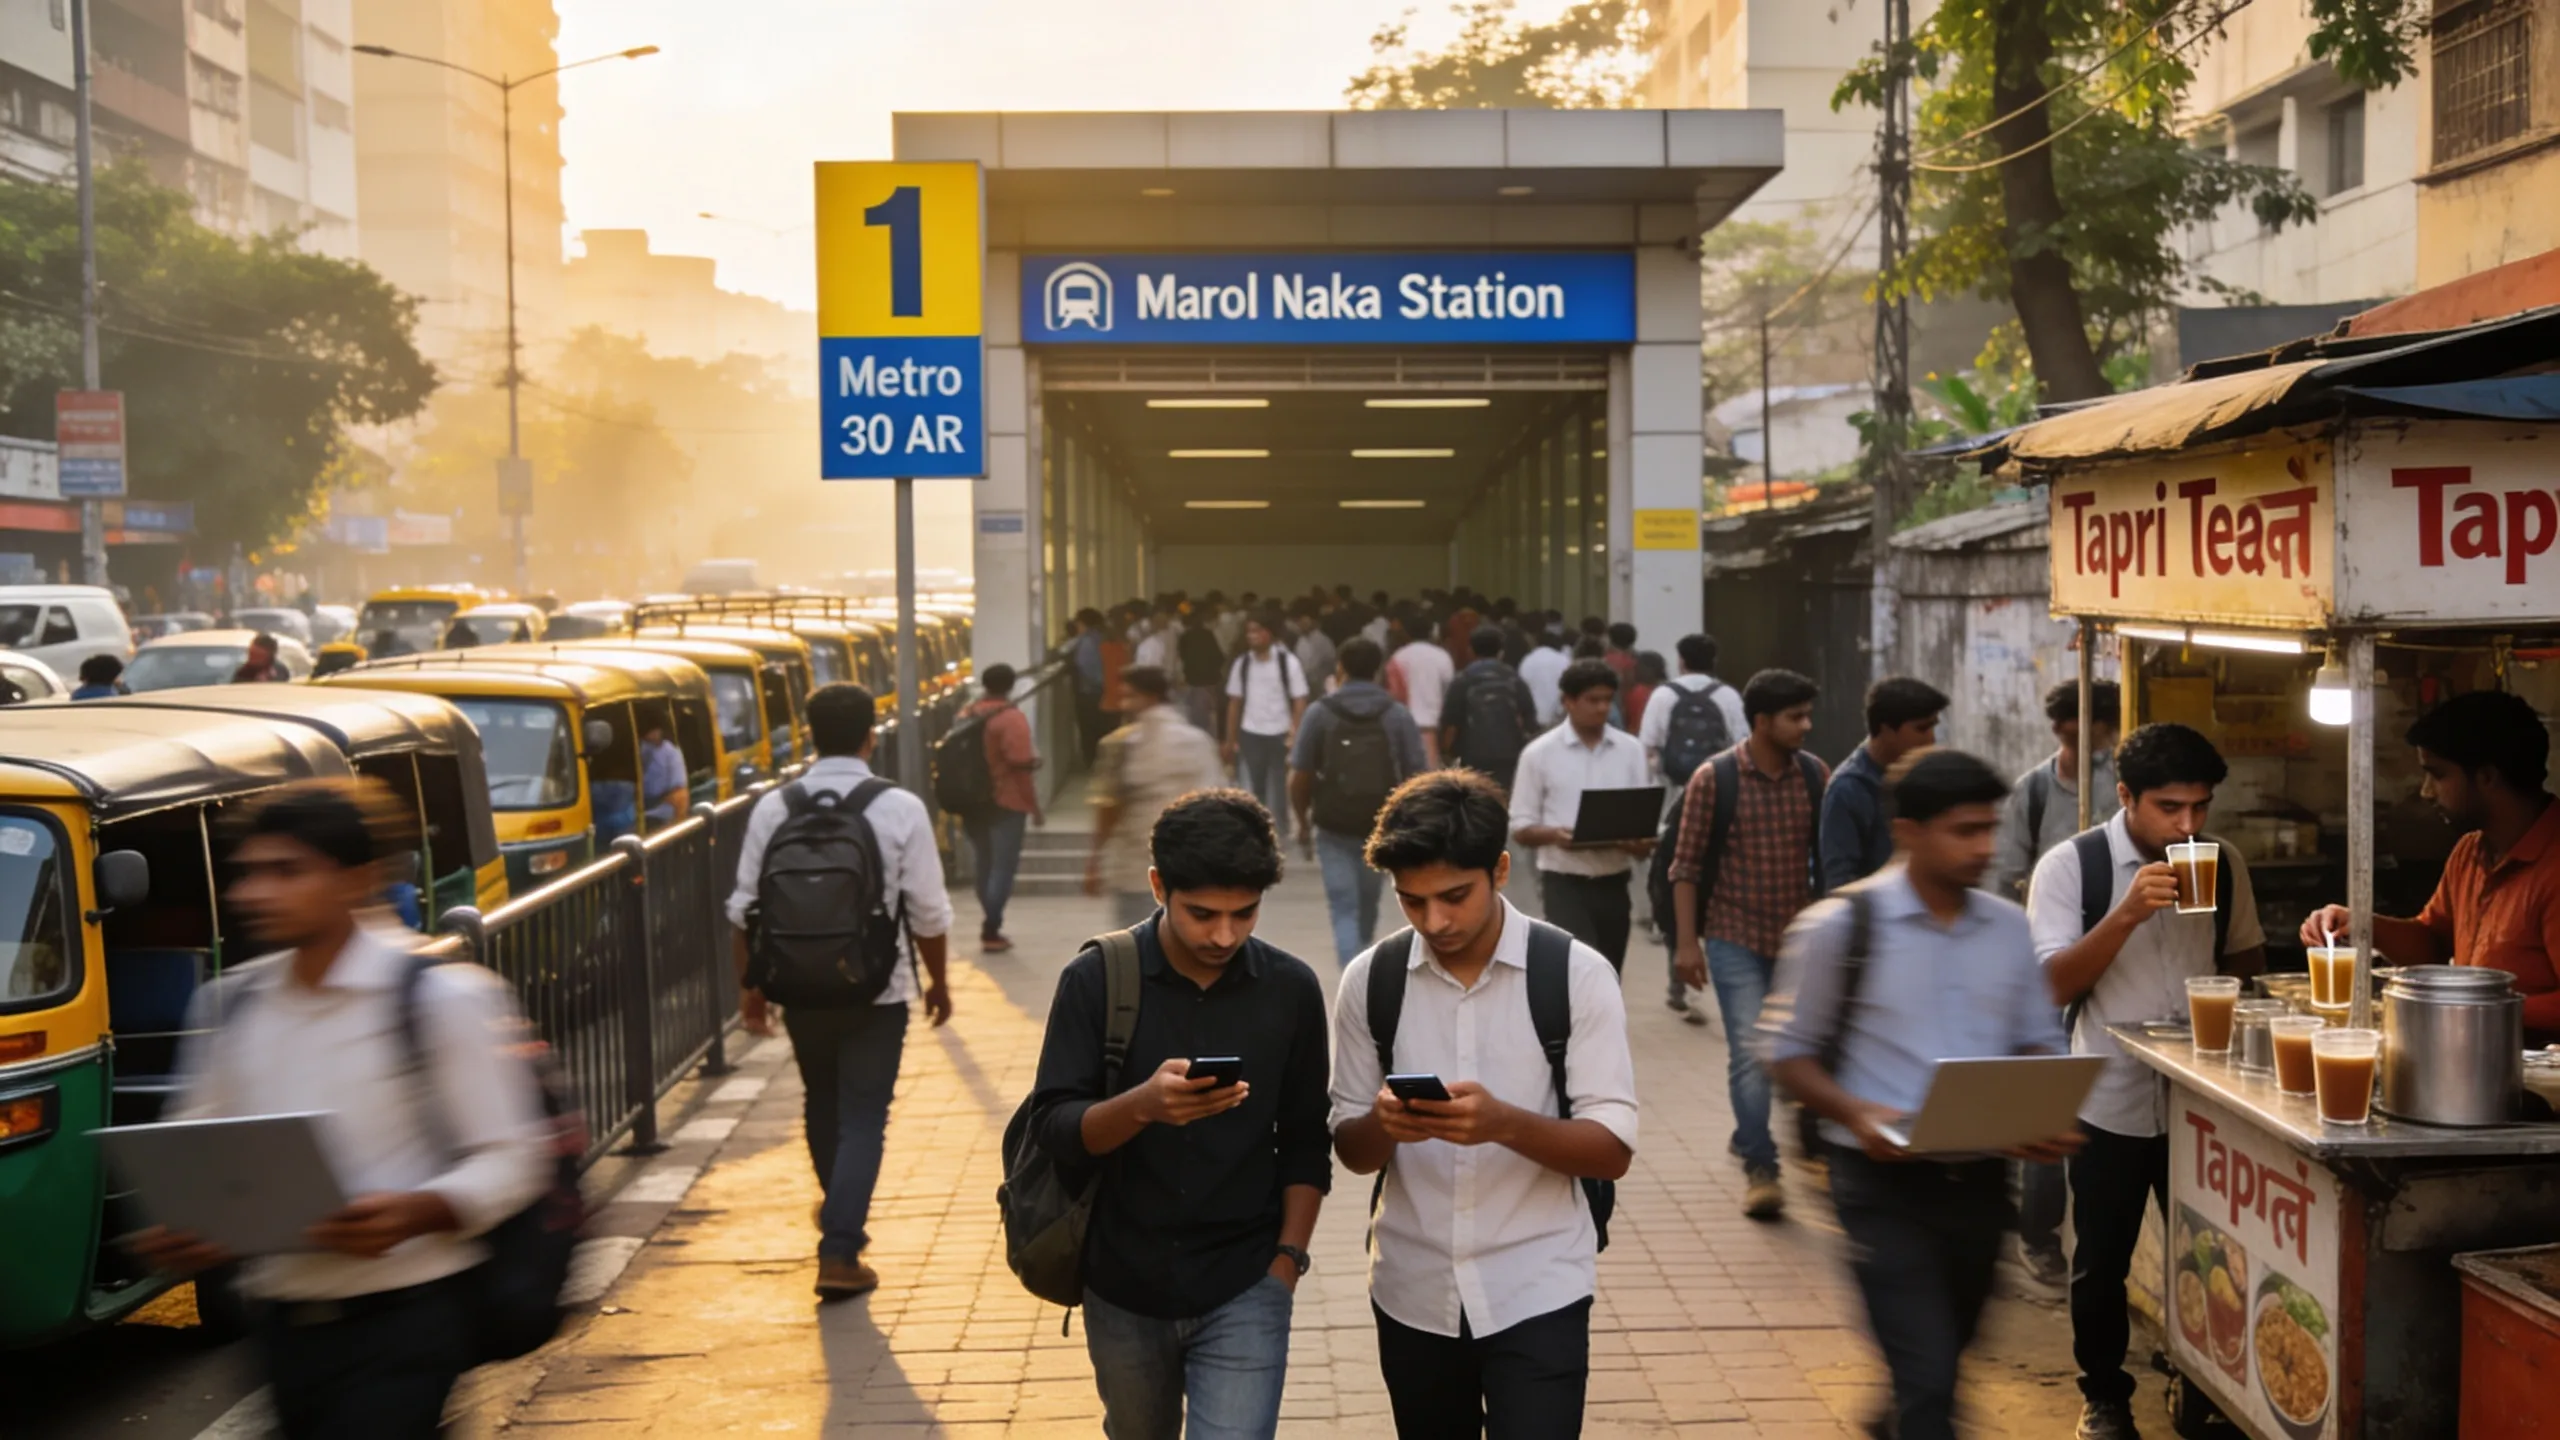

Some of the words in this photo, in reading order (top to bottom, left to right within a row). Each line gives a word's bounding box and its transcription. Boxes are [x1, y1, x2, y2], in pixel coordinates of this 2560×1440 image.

[863, 186, 923, 317] 1
[1137, 272, 1258, 320] Marol
[1273, 272, 1382, 320] Naka
[1399, 271, 1566, 320] Station
[839, 356, 963, 398] Metro
[840, 413, 894, 456] 30
[904, 414, 965, 454] AR
[2062, 480, 2167, 598] Tapri
[2391, 466, 2560, 585] Tap
